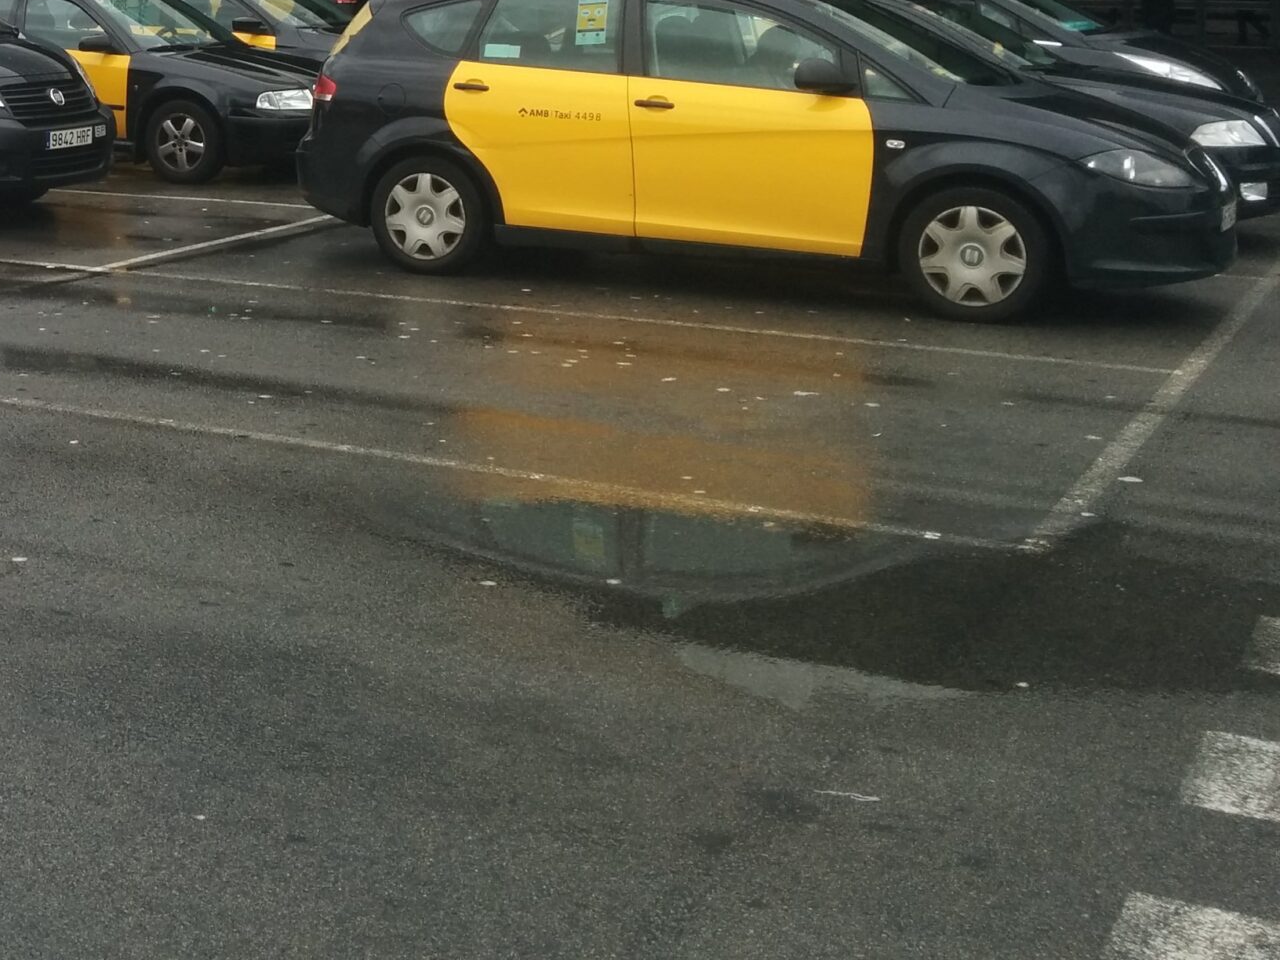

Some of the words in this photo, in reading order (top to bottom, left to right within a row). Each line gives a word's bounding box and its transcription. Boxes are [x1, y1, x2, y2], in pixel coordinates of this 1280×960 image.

[529, 108, 549, 118] AMB
[554, 110, 571, 119] Taxi
[575, 112, 601, 121] 4498
[51, 131, 74, 147] 9842
